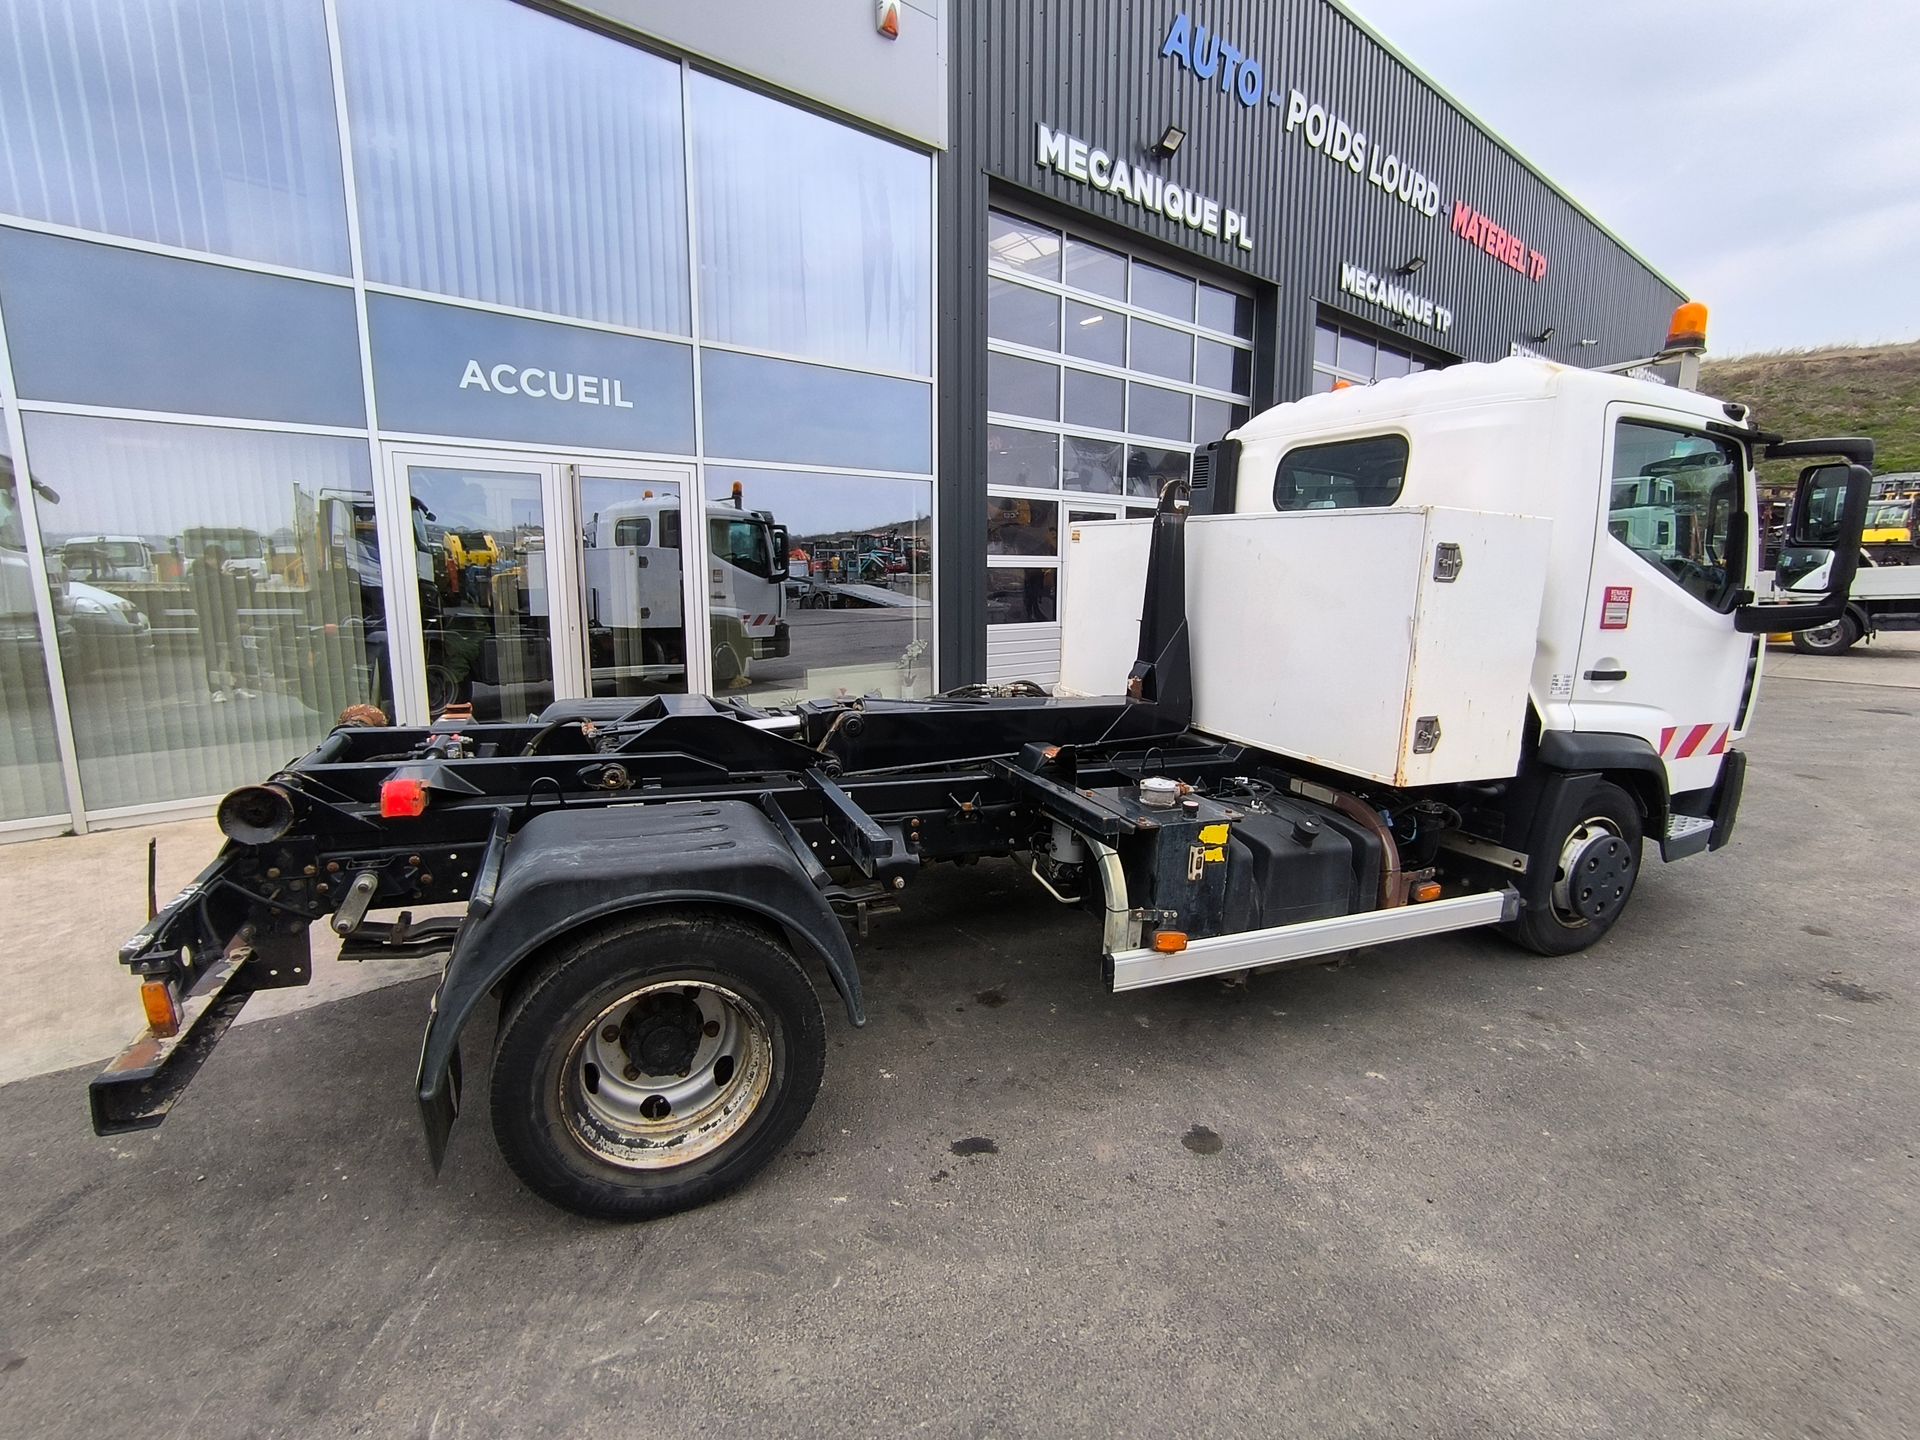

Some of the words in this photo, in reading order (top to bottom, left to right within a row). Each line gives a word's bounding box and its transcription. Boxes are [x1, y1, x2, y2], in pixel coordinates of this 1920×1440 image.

[1037, 124, 1218, 236] MECANIQUE
[1224, 209, 1253, 250] PL
[1160, 11, 1262, 106] AUTO
[1286, 88, 1367, 173] POIDS
[1368, 143, 1440, 217] LOURD
[1452, 200, 1525, 274] MATERIEL
[1528, 249, 1547, 282] TP
[1341, 261, 1433, 326] MECANIQUE
[1434, 306, 1452, 333] TP
[459, 359, 634, 408] ACCUEIL
